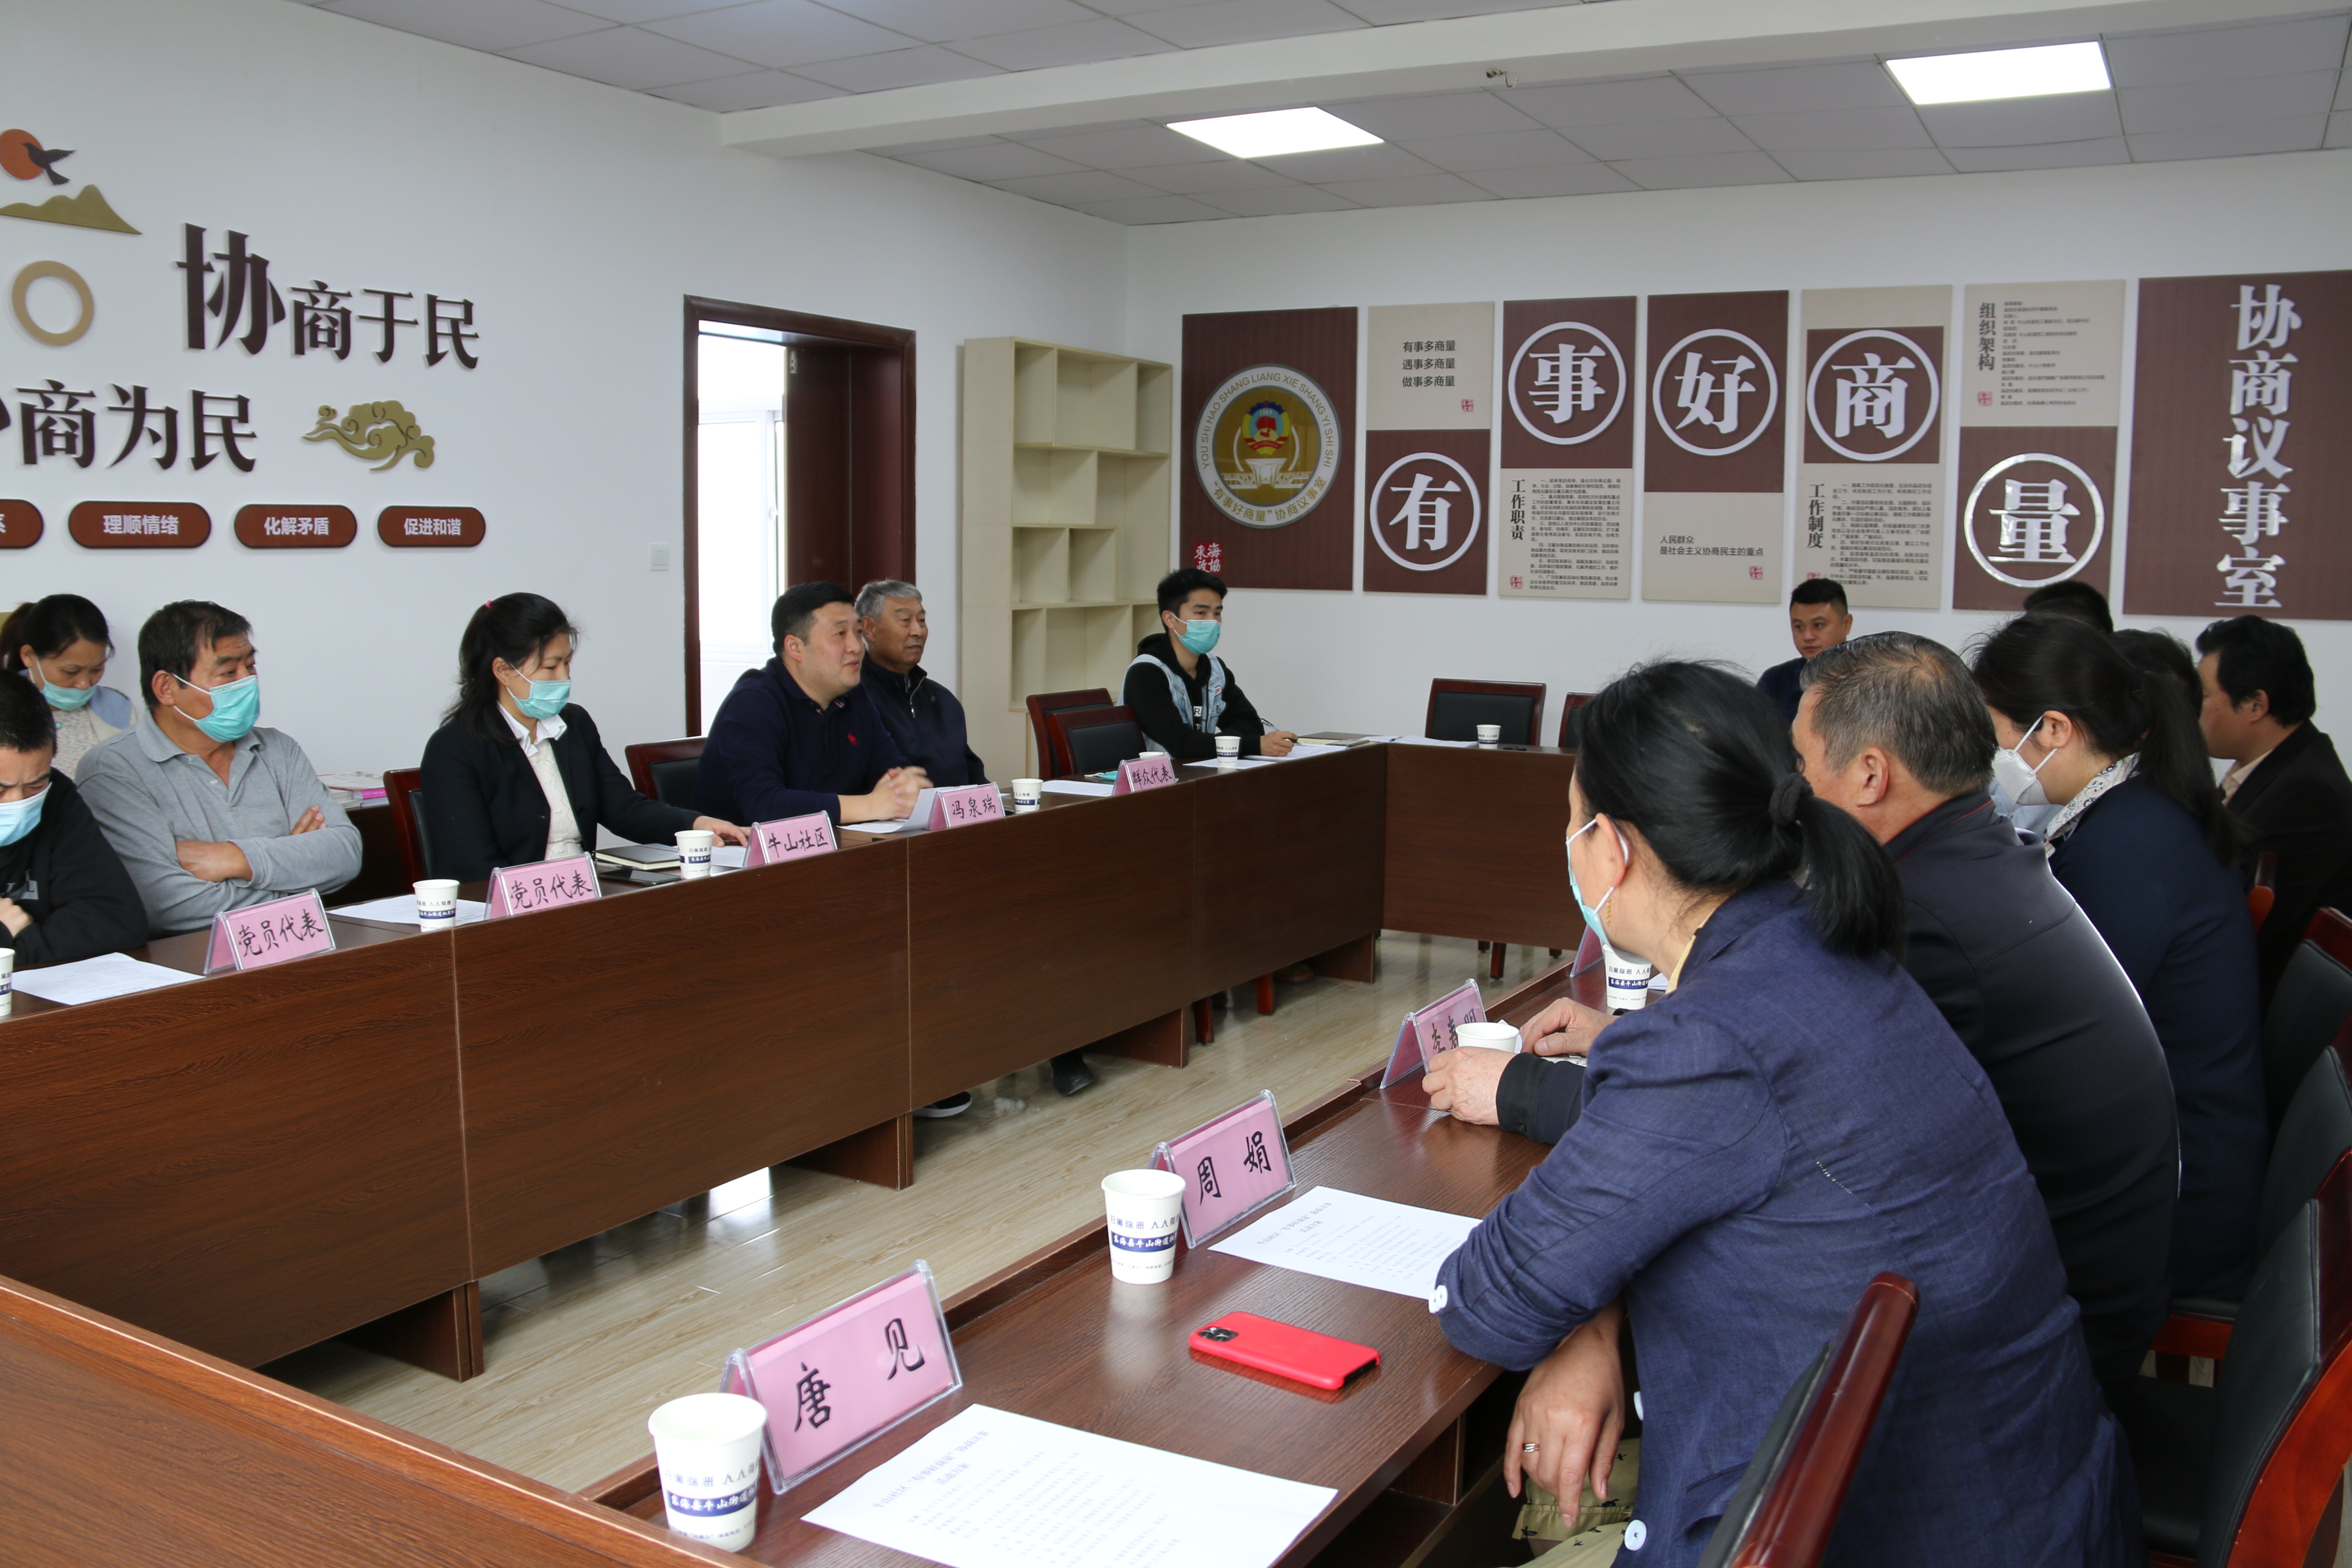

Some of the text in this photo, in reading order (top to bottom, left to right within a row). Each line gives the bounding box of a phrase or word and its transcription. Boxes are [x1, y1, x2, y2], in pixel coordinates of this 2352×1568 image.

[175, 223, 479, 369] 协商于民
[1403, 340, 1456, 352] 有事多商量
[1978, 302, 1996, 371] 组织架构
[1403, 358, 1455, 370] 遇事多商量
[1219, 377, 1250, 402] SHANG
[1251, 372, 1280, 383] LIANG
[1282, 374, 1299, 388] XIE
[1402, 376, 1455, 387] 做事多商量
[1528, 343, 1606, 424] 事
[1298, 383, 1326, 415] SHANG
[1674, 351, 1756, 434] 好
[1831, 352, 1916, 438] 商
[1206, 402, 1221, 424] HAO
[1322, 415, 1331, 427] YI
[0, 379, 257, 472] 商为民
[1201, 426, 1210, 443] SHI
[1201, 445, 1210, 469] YOU
[1323, 449, 1333, 467] SHI
[2214, 284, 2303, 608] 协商议事室
[1389, 473, 1461, 551] 有
[1510, 479, 1525, 541] 工作职责
[1807, 484, 1825, 549] 工作制度
[1988, 478, 2081, 563] 量
[103, 514, 178, 536] 理顺情绪
[263, 517, 329, 536] 化解矛盾
[404, 518, 462, 536] 促进和谐
[1660, 535, 1694, 544] 人民群众
[1660, 546, 1764, 557] 是社会主义协商民主的重点
[1132, 762, 1173, 786] 群众代表
[951, 794, 996, 818] 冯泉瑞
[768, 827, 828, 858] 牛山社区
[509, 870, 593, 910] 党员代表
[237, 908, 324, 957] 党员代表
